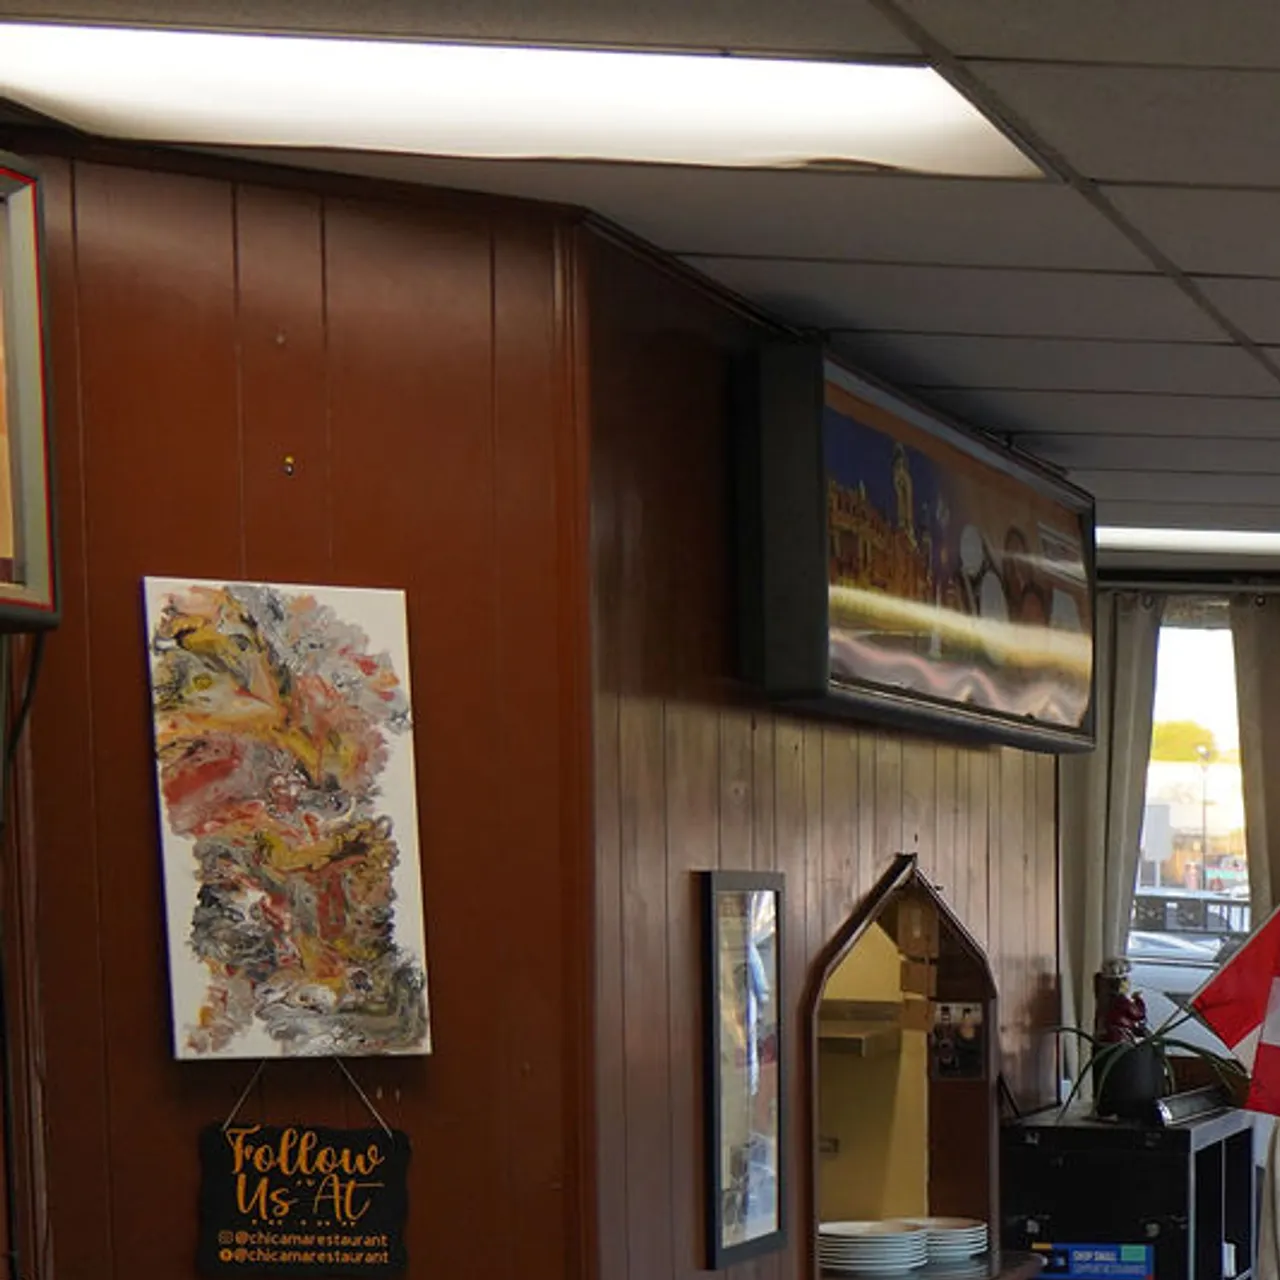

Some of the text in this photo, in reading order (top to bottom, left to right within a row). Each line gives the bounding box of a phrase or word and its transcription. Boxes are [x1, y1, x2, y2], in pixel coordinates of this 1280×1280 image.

[226, 1124, 386, 1175] Follow
[235, 1173, 385, 1221] Us At
[235, 1231, 389, 1247] @chicamarestaurant
[235, 1248, 390, 1265] @chicamarestaurant
